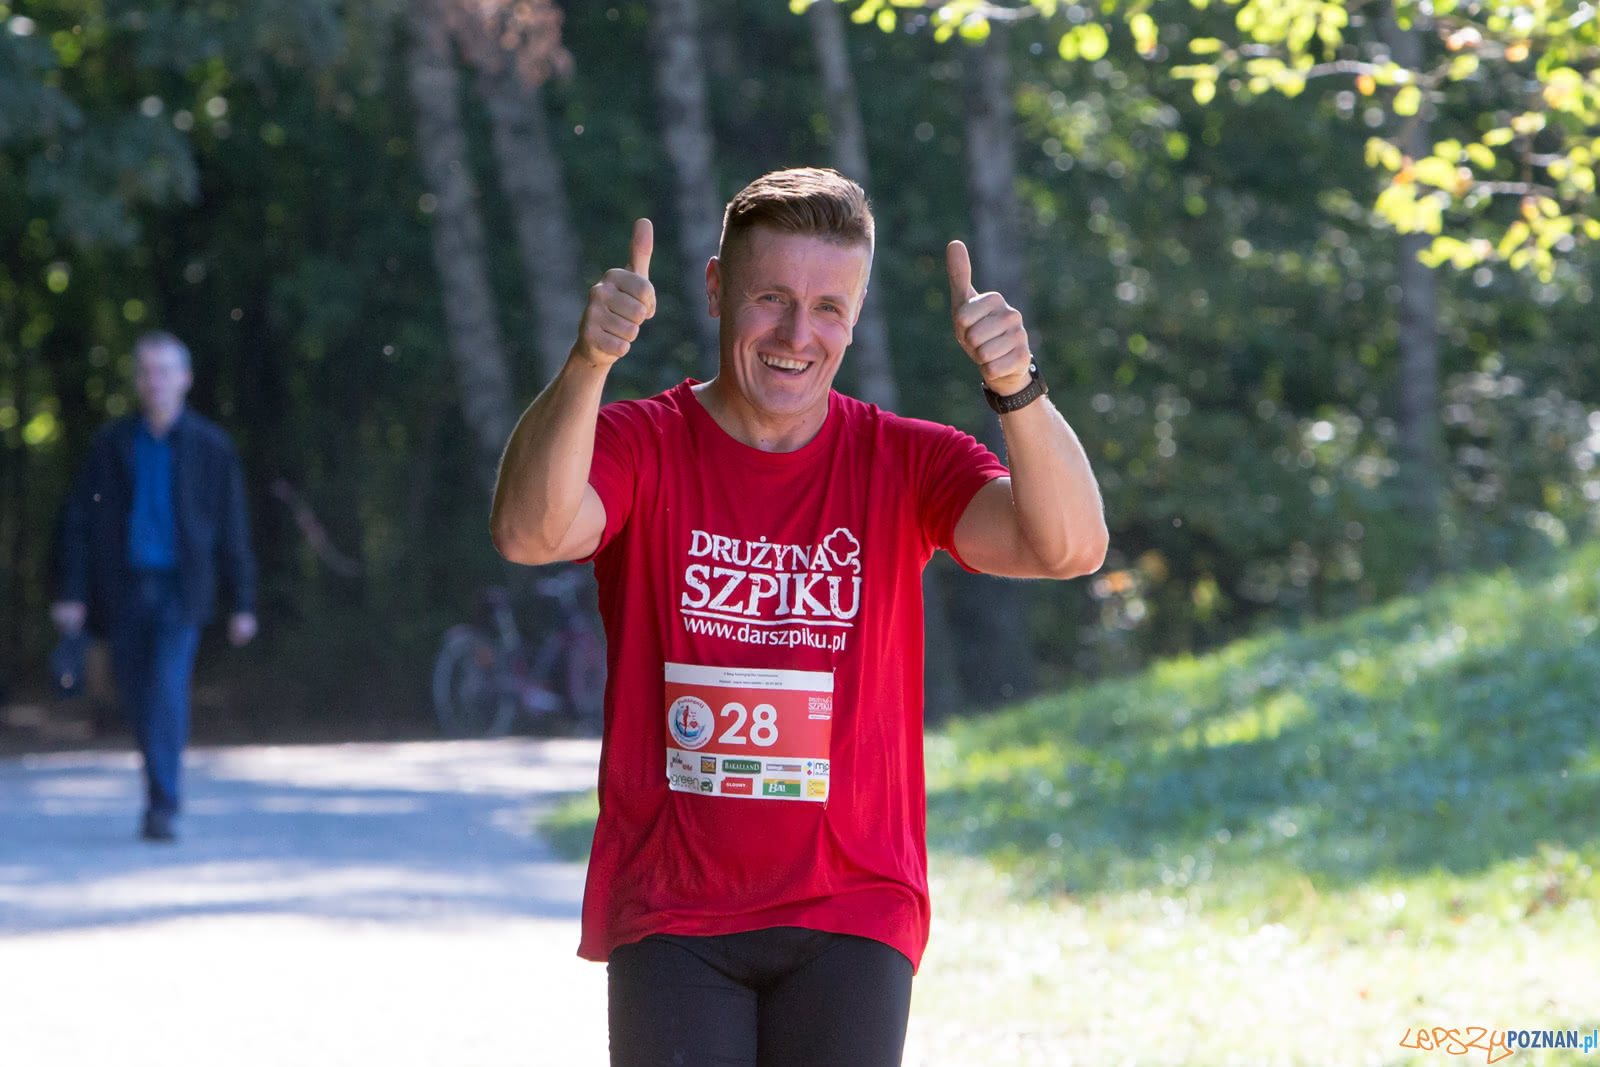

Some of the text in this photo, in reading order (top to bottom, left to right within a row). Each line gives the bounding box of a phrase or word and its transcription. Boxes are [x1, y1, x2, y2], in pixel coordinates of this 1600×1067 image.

[688, 530, 832, 571] DRUŻYNA
[681, 564, 862, 620] SZPIKU
[683, 617, 847, 653] www.darszpiku.pl
[718, 702, 779, 747] 28
